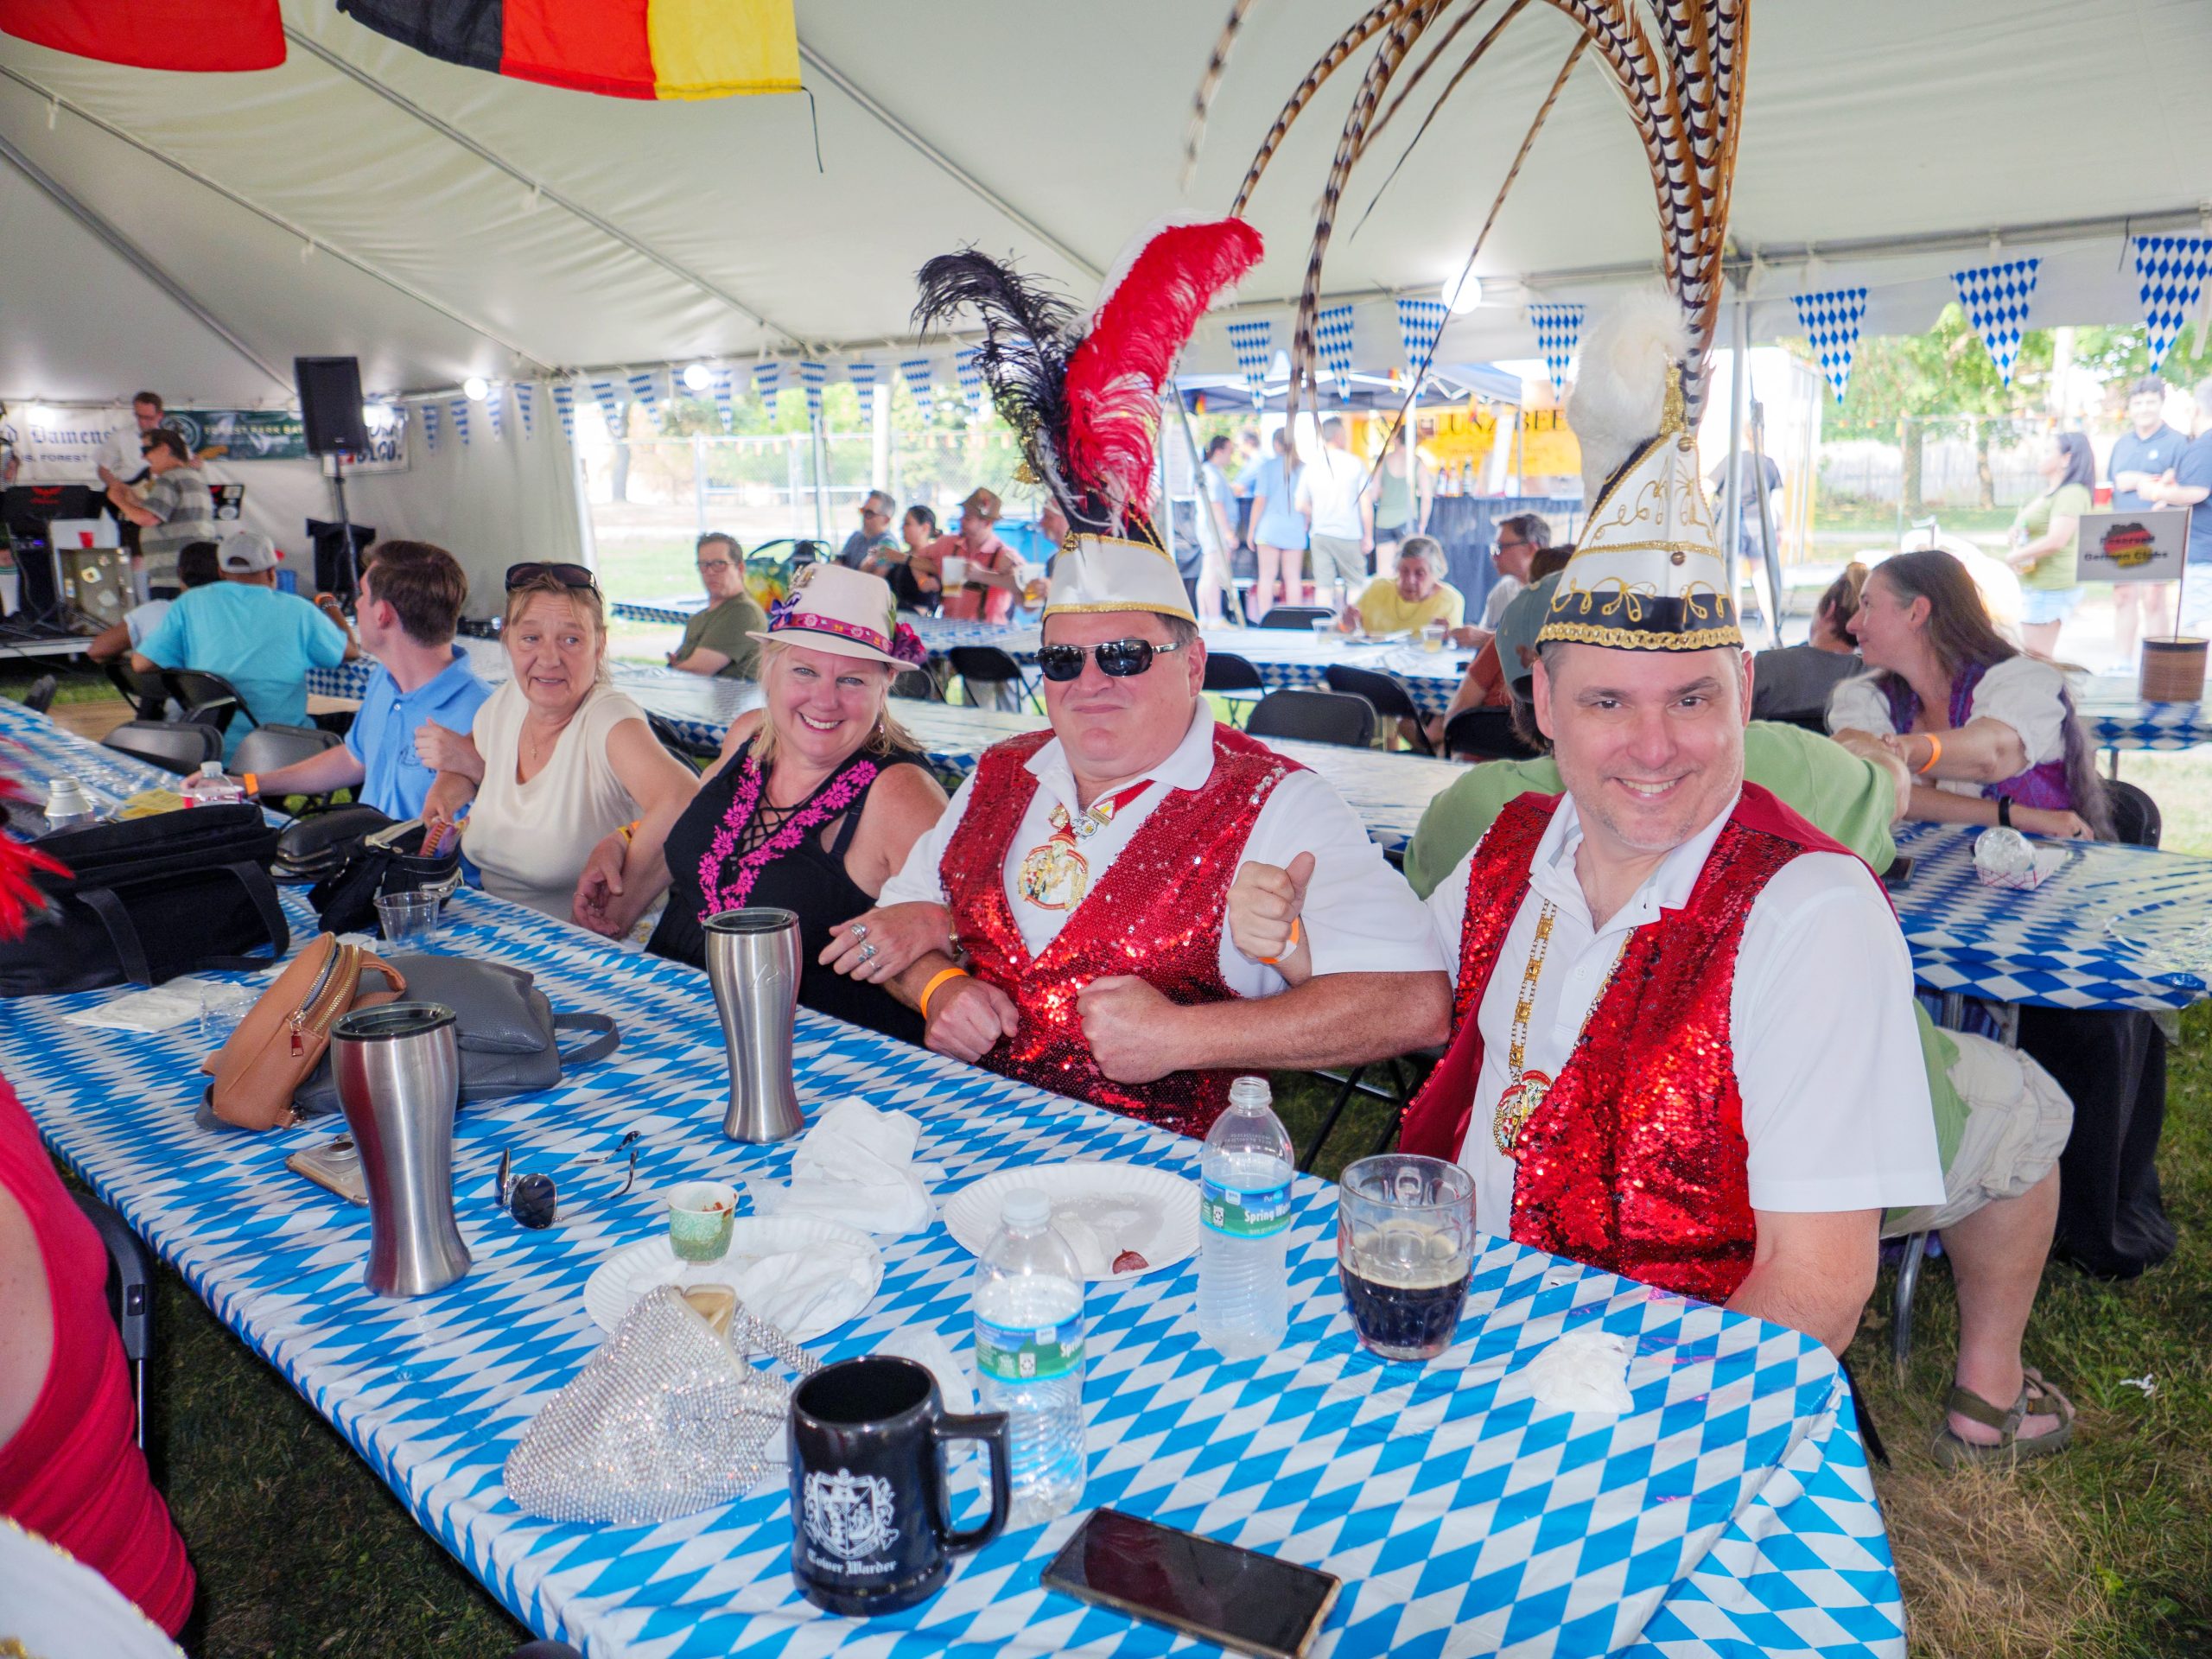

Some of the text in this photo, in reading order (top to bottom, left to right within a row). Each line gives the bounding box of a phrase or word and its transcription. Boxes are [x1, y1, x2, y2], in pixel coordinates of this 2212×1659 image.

[40, 454, 88, 463] FOREST
[2084, 552, 2131, 562] German
[1244, 1209, 1274, 1224] Spring
